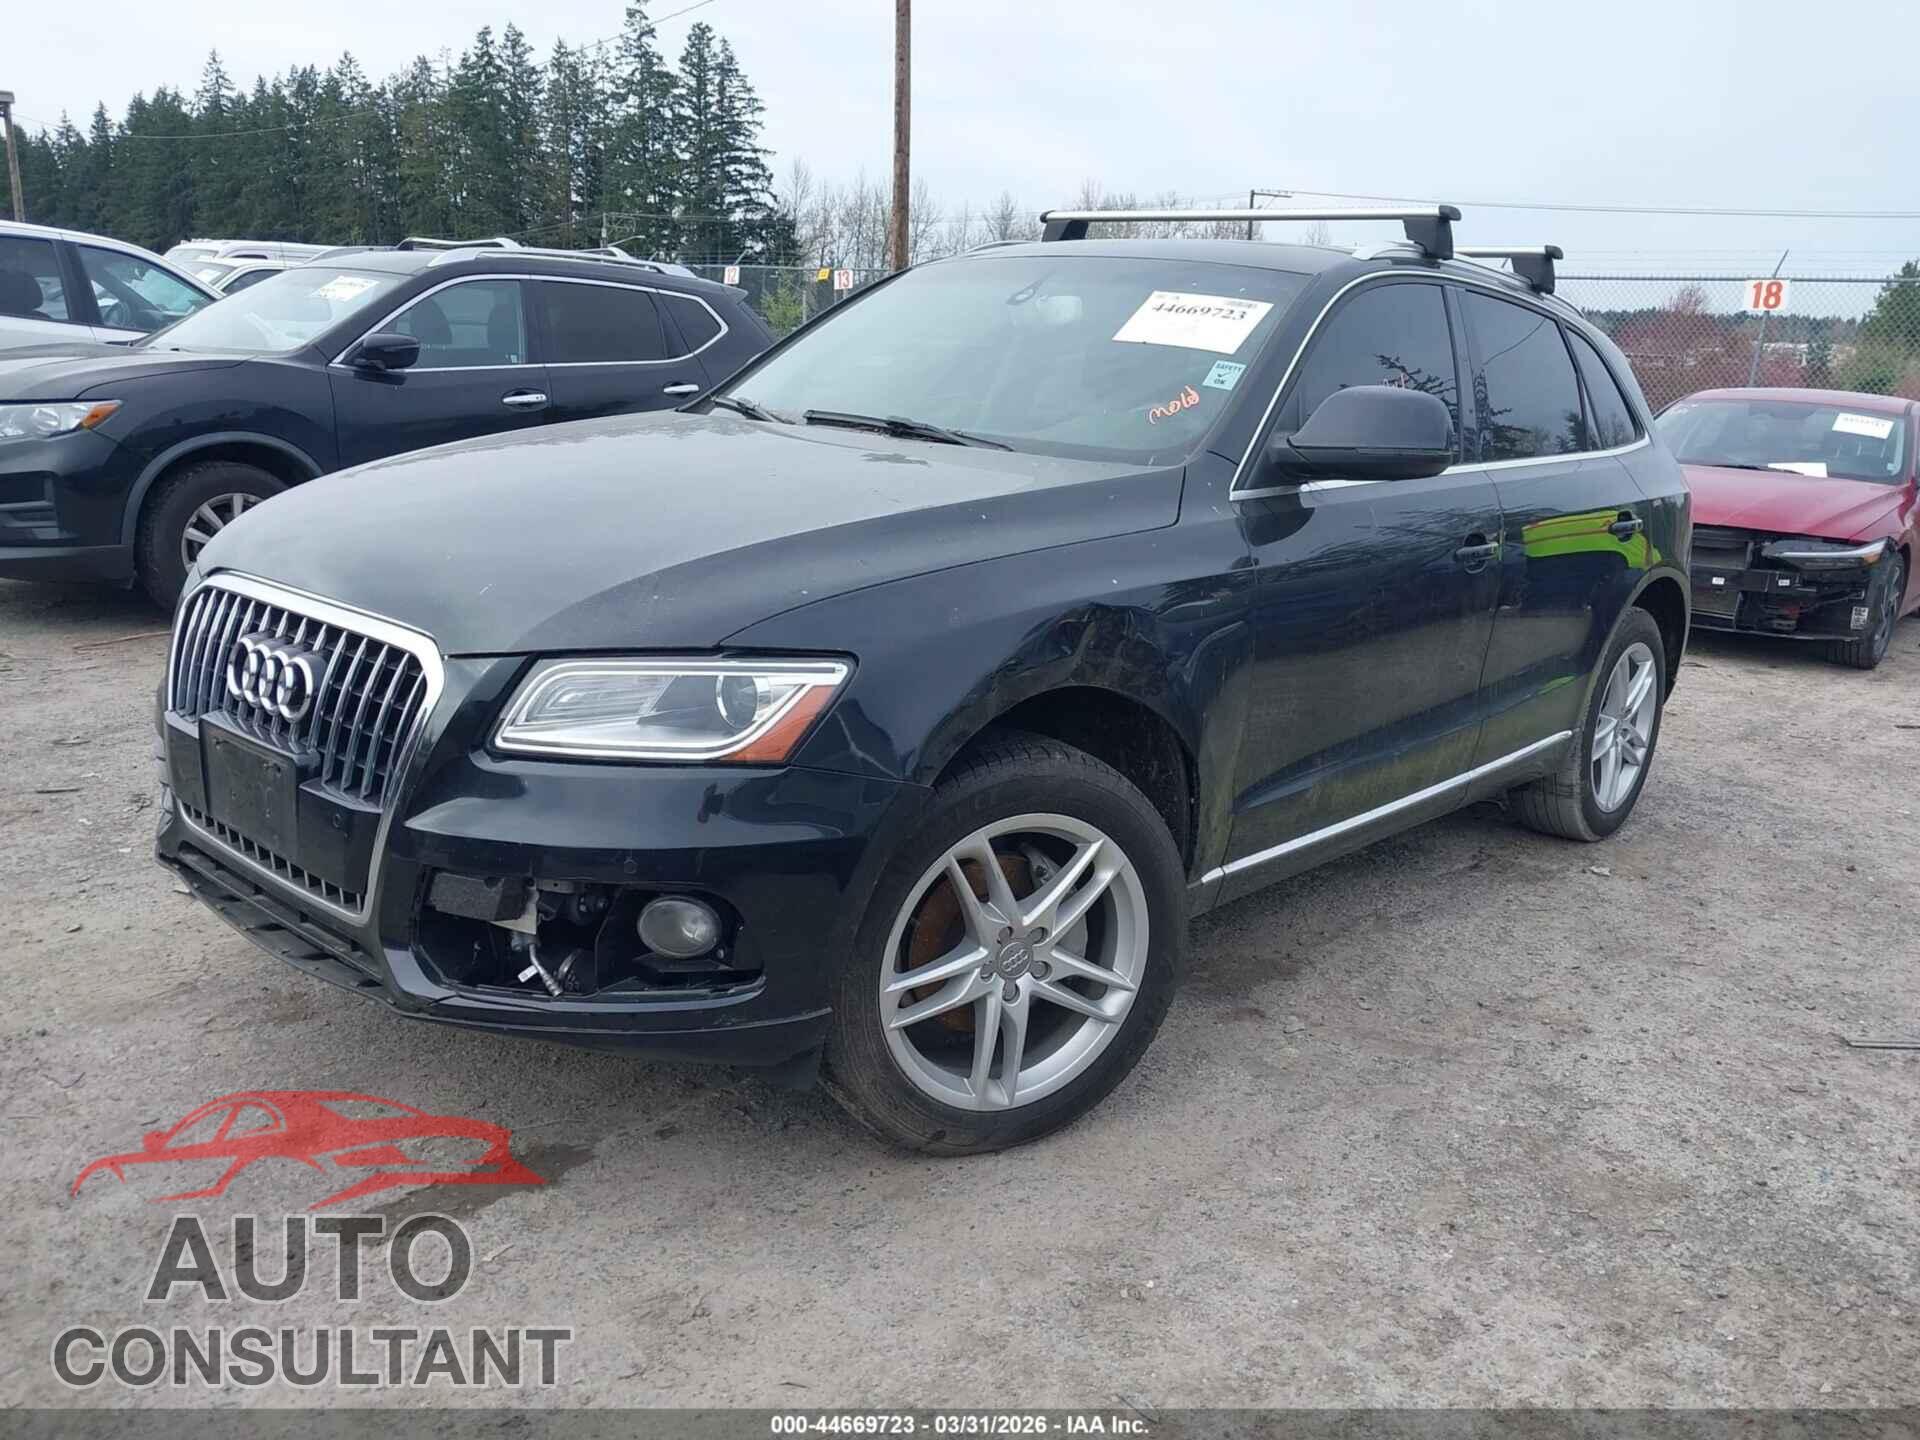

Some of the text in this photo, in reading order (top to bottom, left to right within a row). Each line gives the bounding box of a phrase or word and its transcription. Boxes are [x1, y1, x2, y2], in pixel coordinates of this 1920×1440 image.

[727, 268, 737, 282] 12
[837, 270, 850, 287] 13
[1751, 280, 1783, 310] 18
[1152, 303, 1247, 320] 44669723
